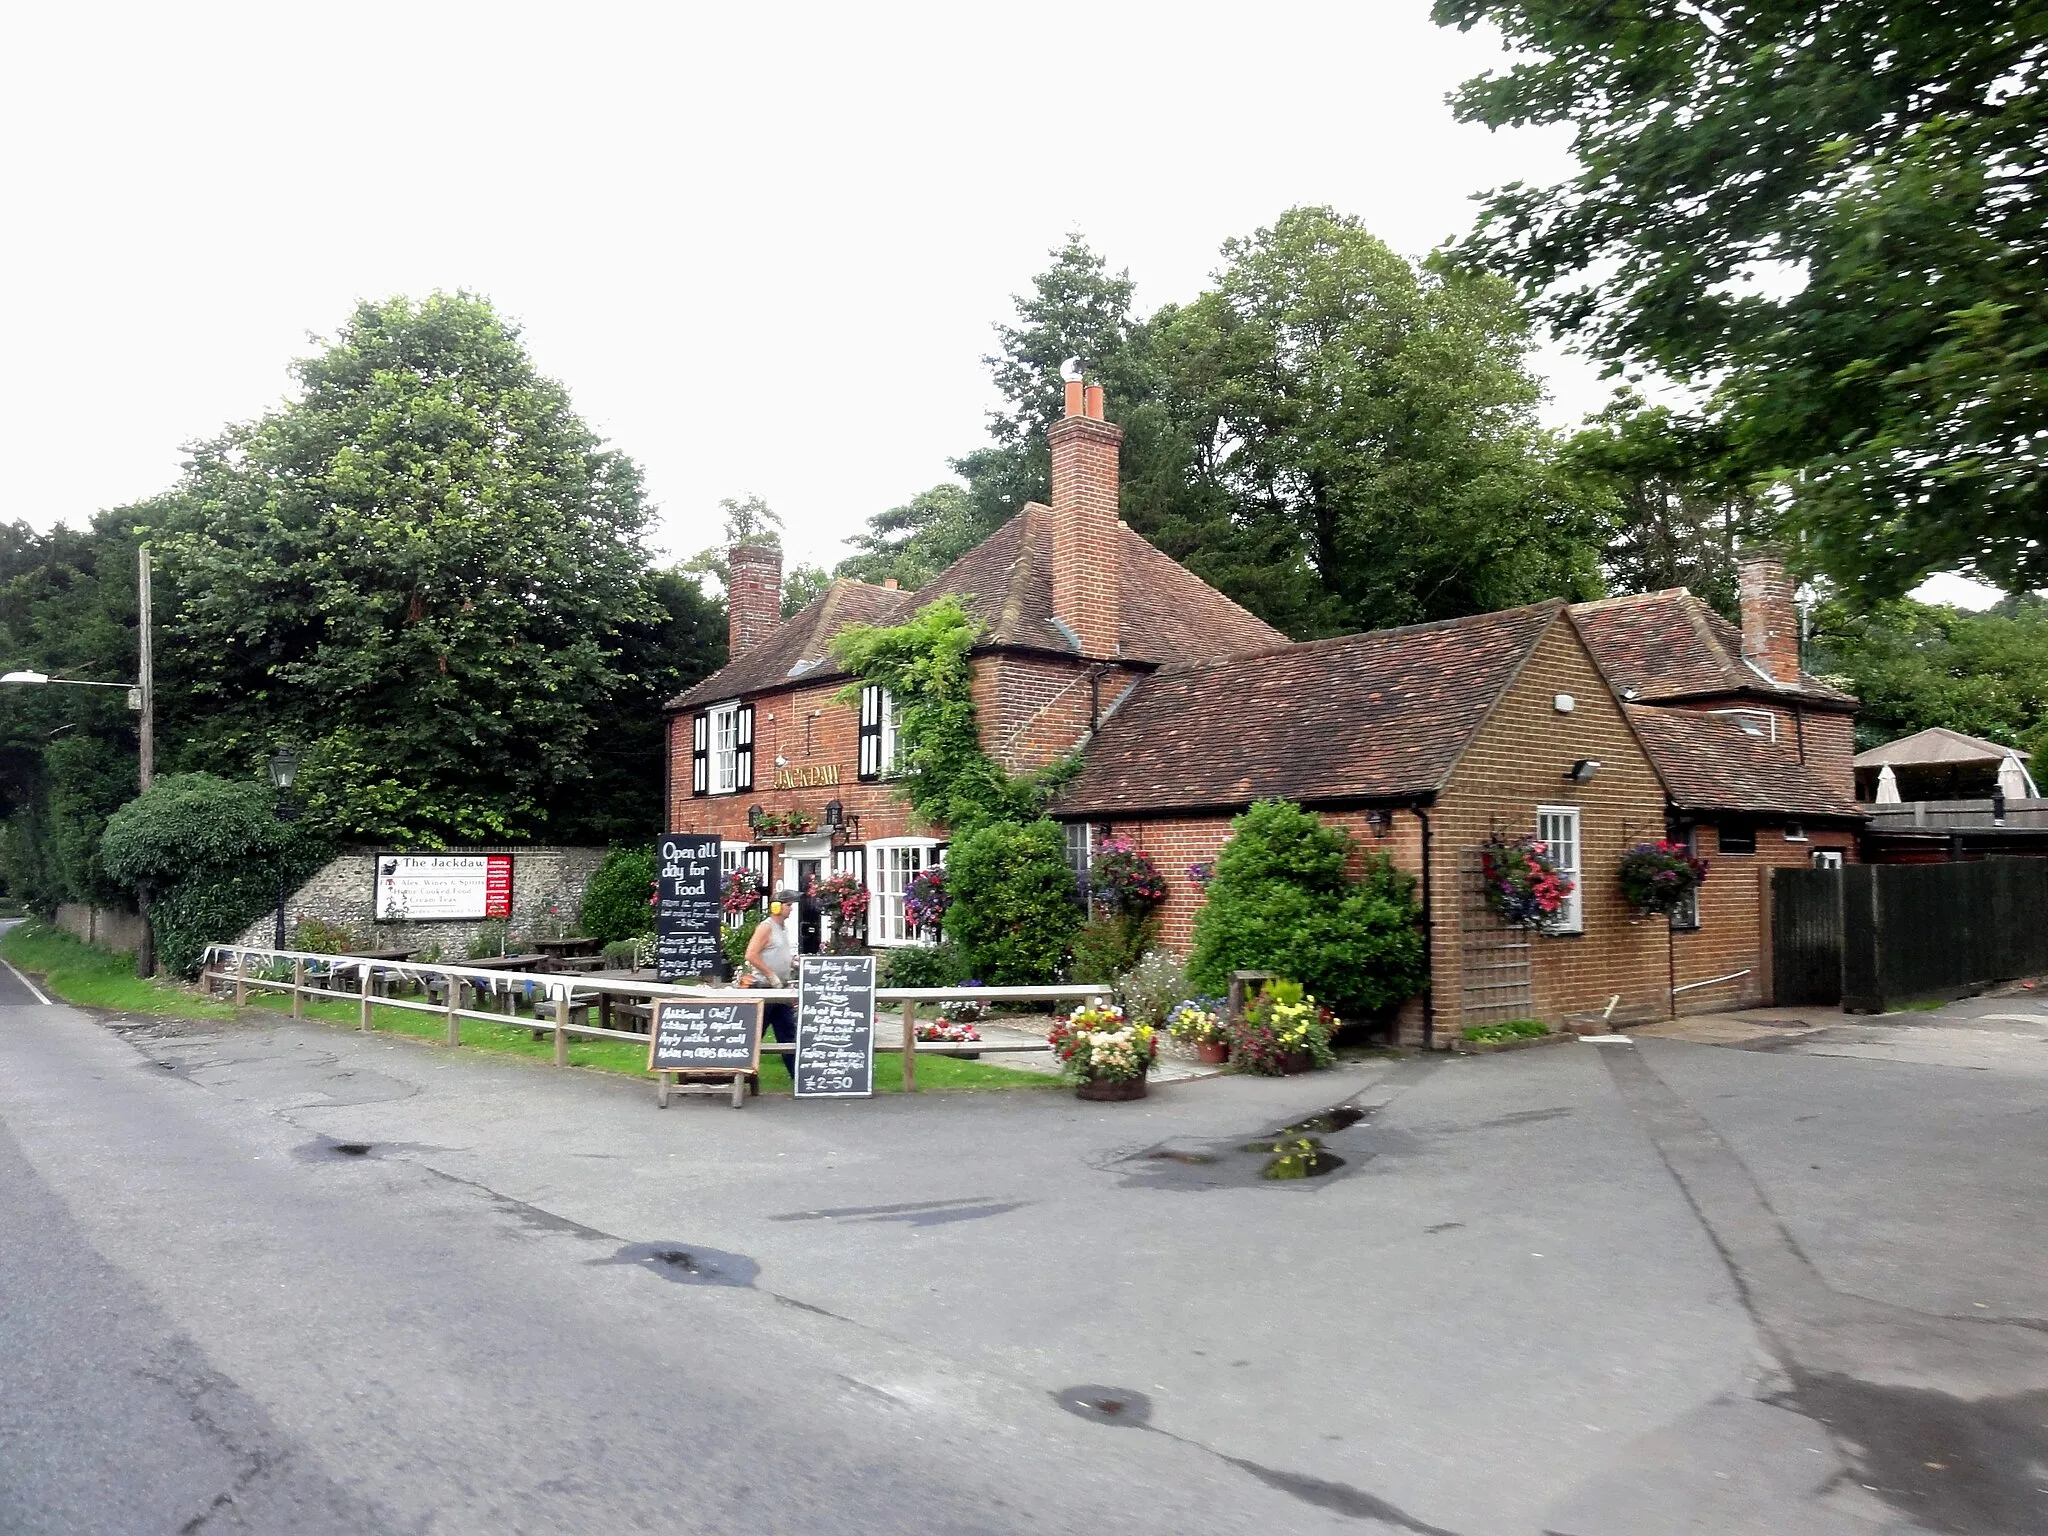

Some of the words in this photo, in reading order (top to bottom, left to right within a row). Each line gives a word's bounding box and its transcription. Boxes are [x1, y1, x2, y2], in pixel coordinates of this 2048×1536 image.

[773, 764, 842, 789] JACKDAW
[403, 858, 427, 868] The
[431, 858, 486, 868] Jackdaw
[662, 841, 696, 864] Open
[697, 842, 719, 859] all
[662, 861, 685, 881] day
[689, 860, 710, 876] for
[675, 879, 706, 896] Food
